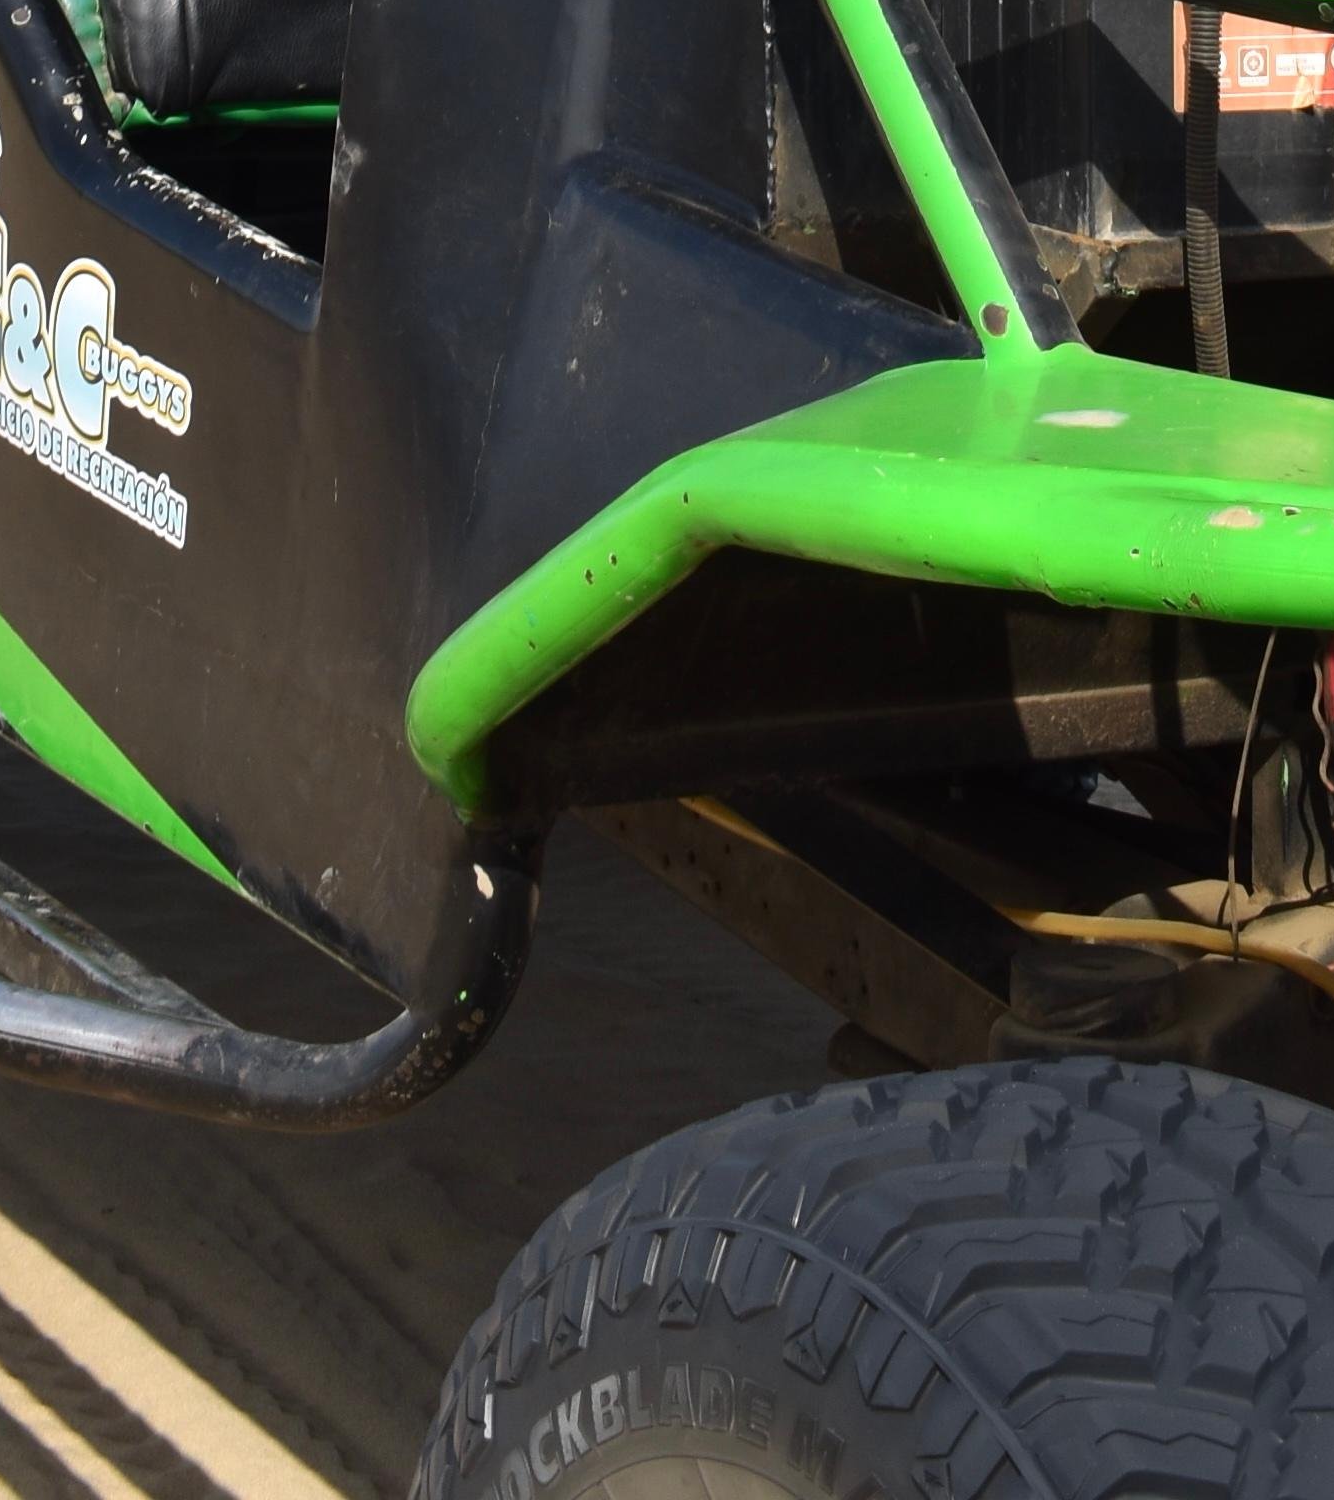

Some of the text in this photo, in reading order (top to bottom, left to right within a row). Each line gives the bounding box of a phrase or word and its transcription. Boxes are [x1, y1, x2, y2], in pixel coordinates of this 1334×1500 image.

[84, 338, 187, 423] BUGGYS
[39, 419, 63, 467] DE
[67, 437, 186, 541] RECREACIÓN
[489, 1361, 777, 1500] OCKBLADE
